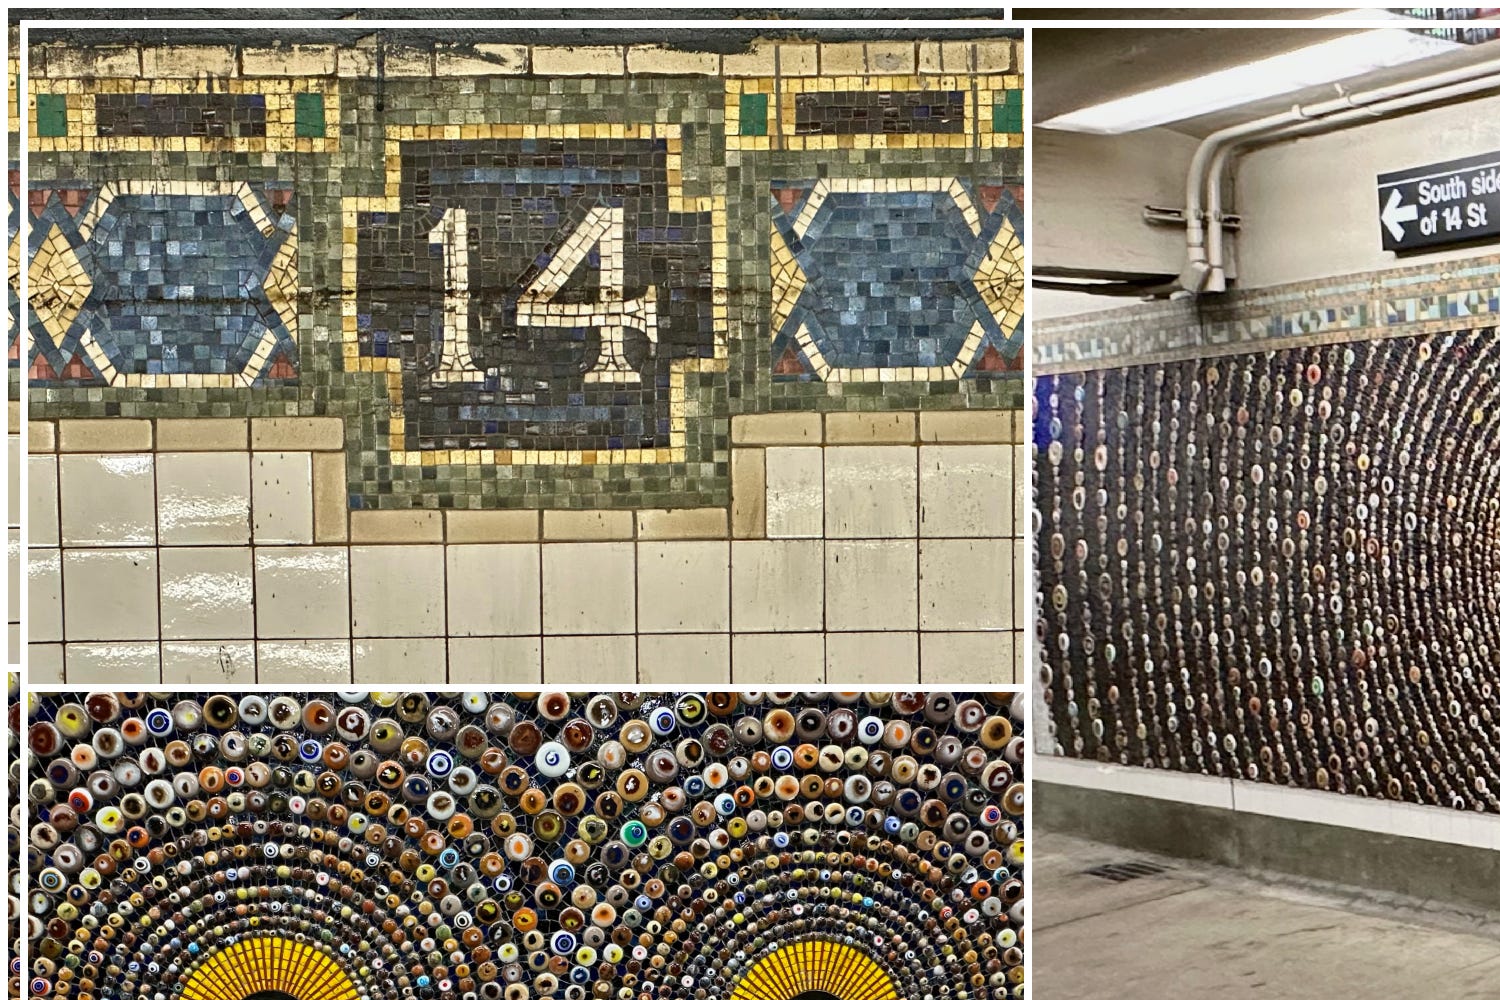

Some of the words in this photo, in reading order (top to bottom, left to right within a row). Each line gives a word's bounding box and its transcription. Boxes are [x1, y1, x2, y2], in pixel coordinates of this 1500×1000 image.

[1418, 175, 1467, 206] South
[1419, 209, 1438, 236] of
[1442, 205, 1463, 232] 14
[1467, 202, 1488, 228] St
[428, 206, 658, 383] 14
